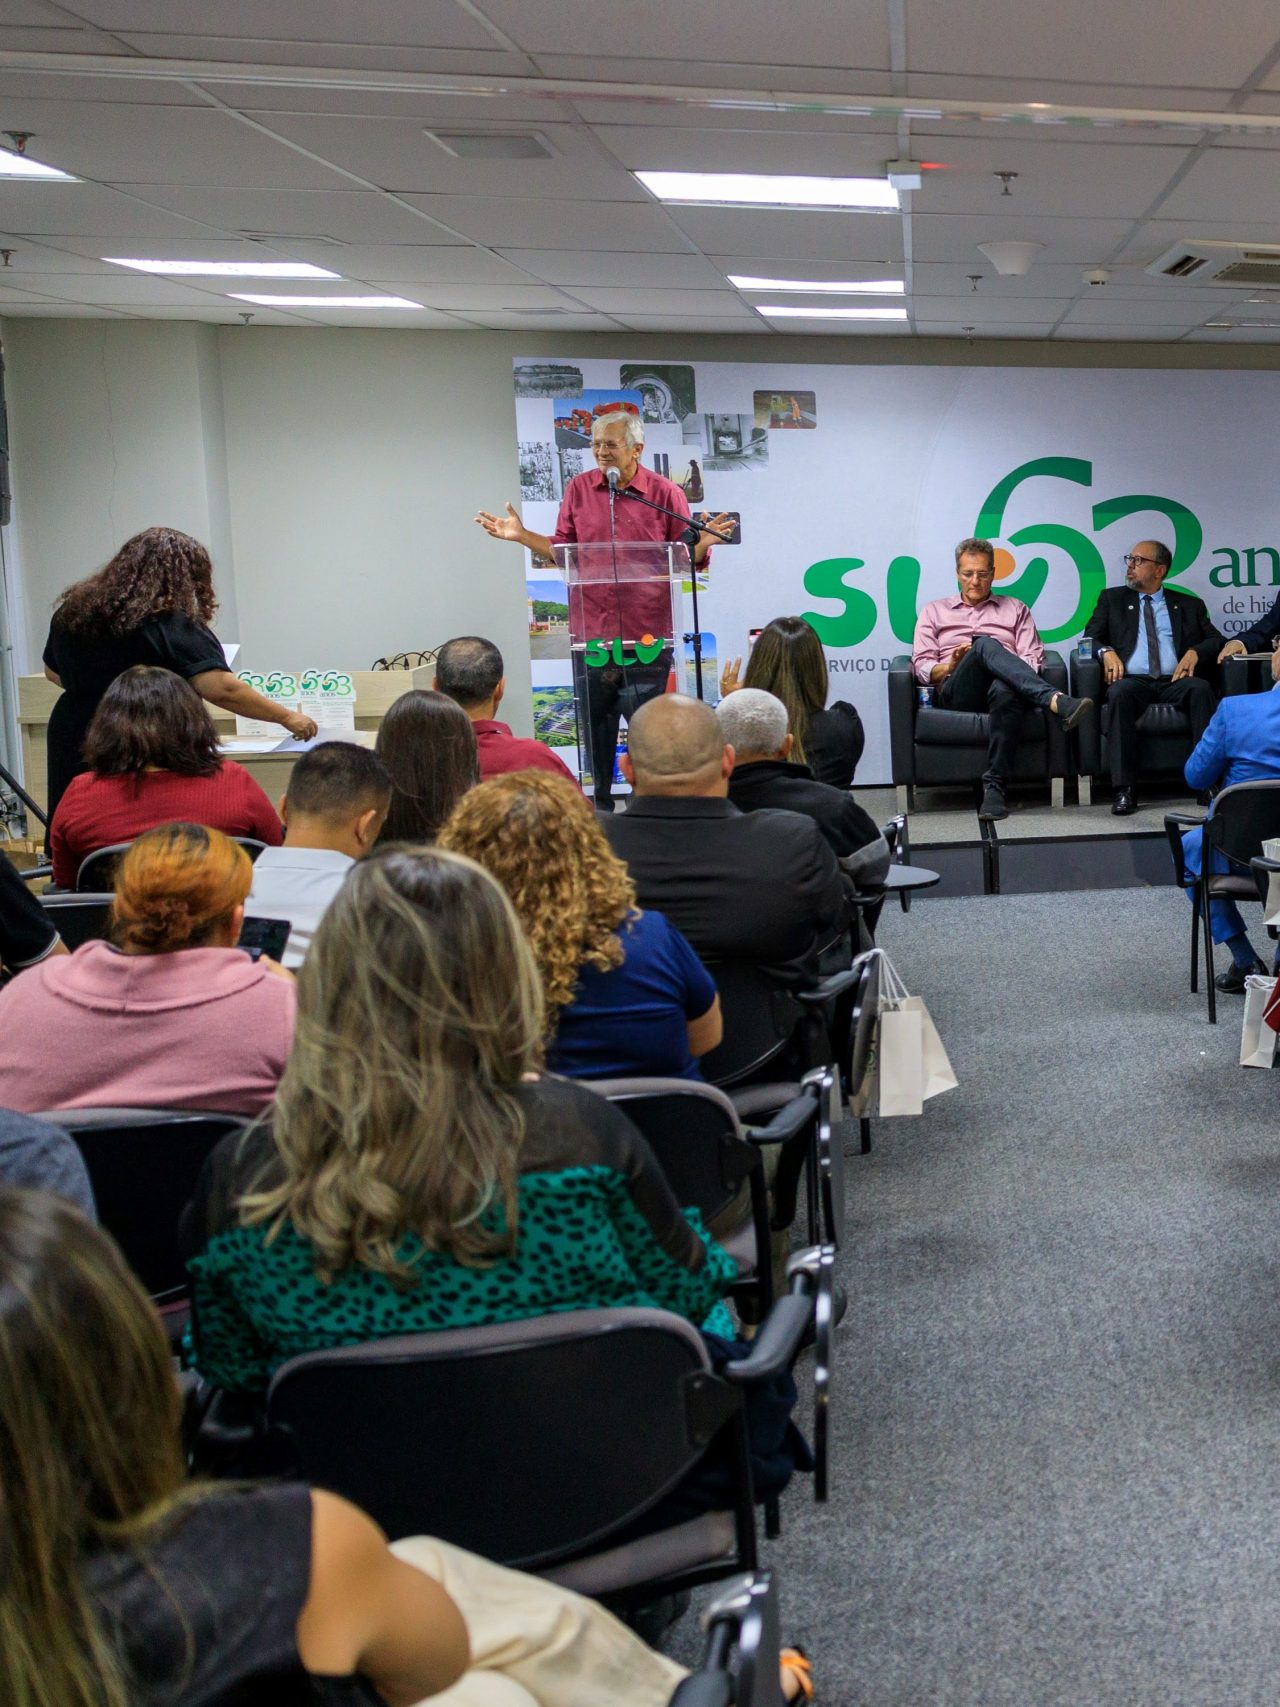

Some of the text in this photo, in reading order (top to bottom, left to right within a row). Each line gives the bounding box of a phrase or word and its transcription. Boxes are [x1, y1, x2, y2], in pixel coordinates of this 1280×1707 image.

[1222, 595, 1275, 614] de his
[827, 658, 876, 675] RVIÇO
